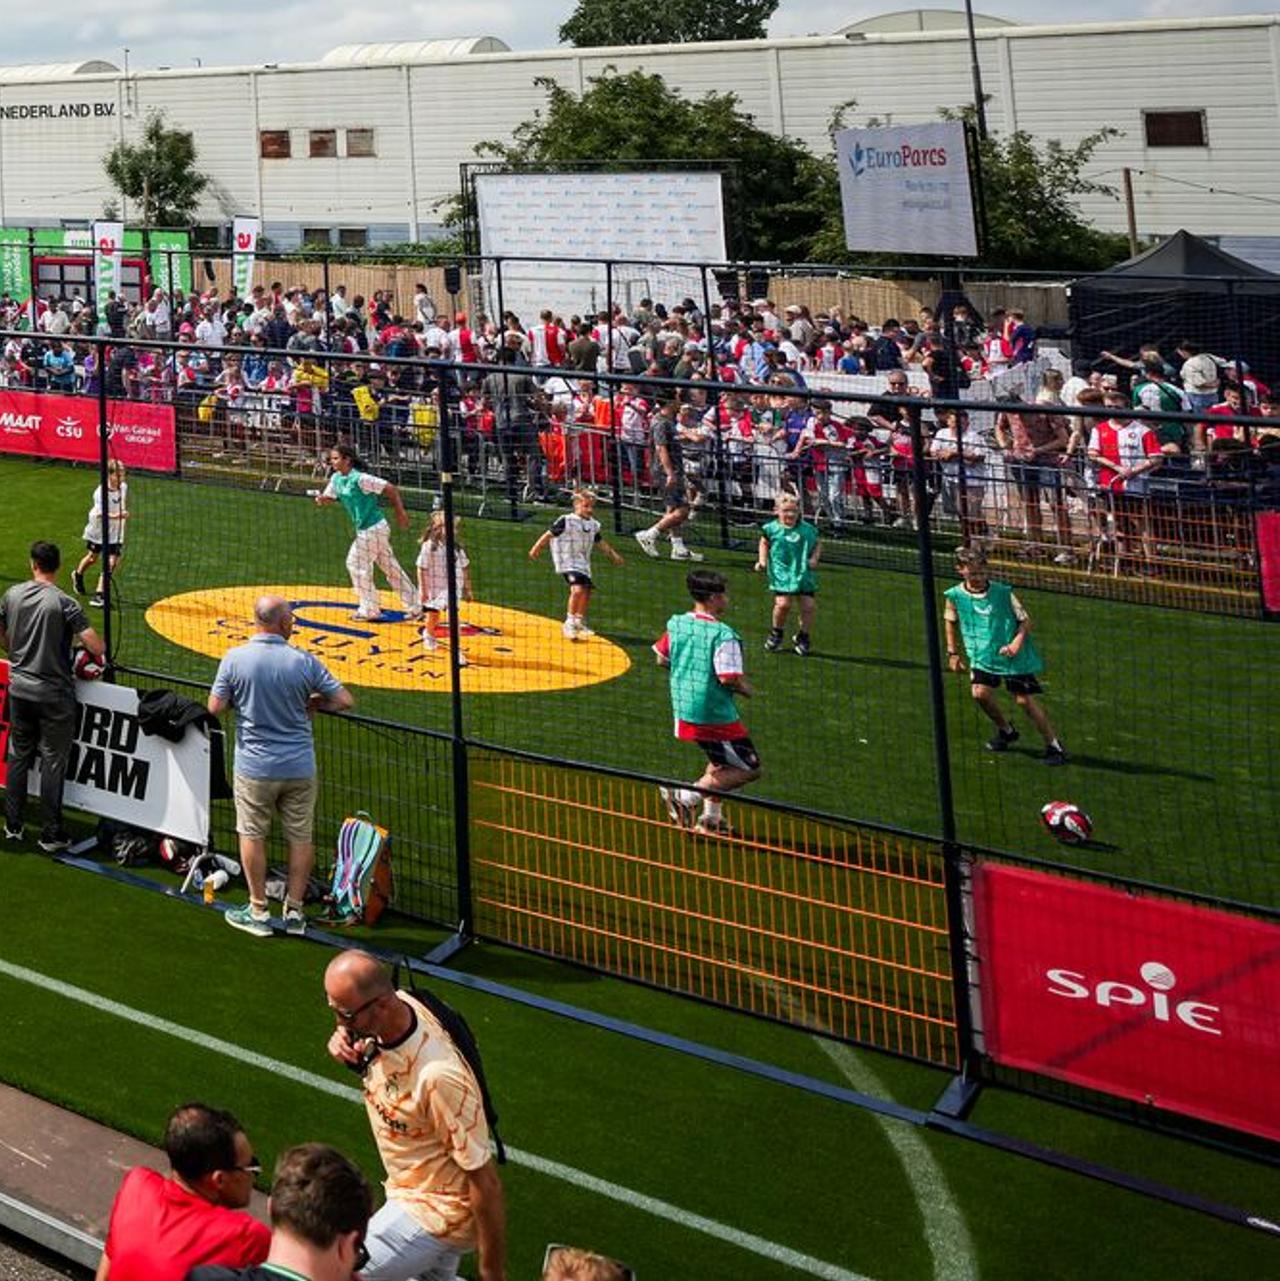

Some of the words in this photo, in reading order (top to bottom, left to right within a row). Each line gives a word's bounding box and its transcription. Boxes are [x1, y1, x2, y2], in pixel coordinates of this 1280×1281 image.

[0, 103, 90, 119] NEDERLAND
[866, 145, 947, 168] EuroParcs
[56, 425, 83, 438] CSU
